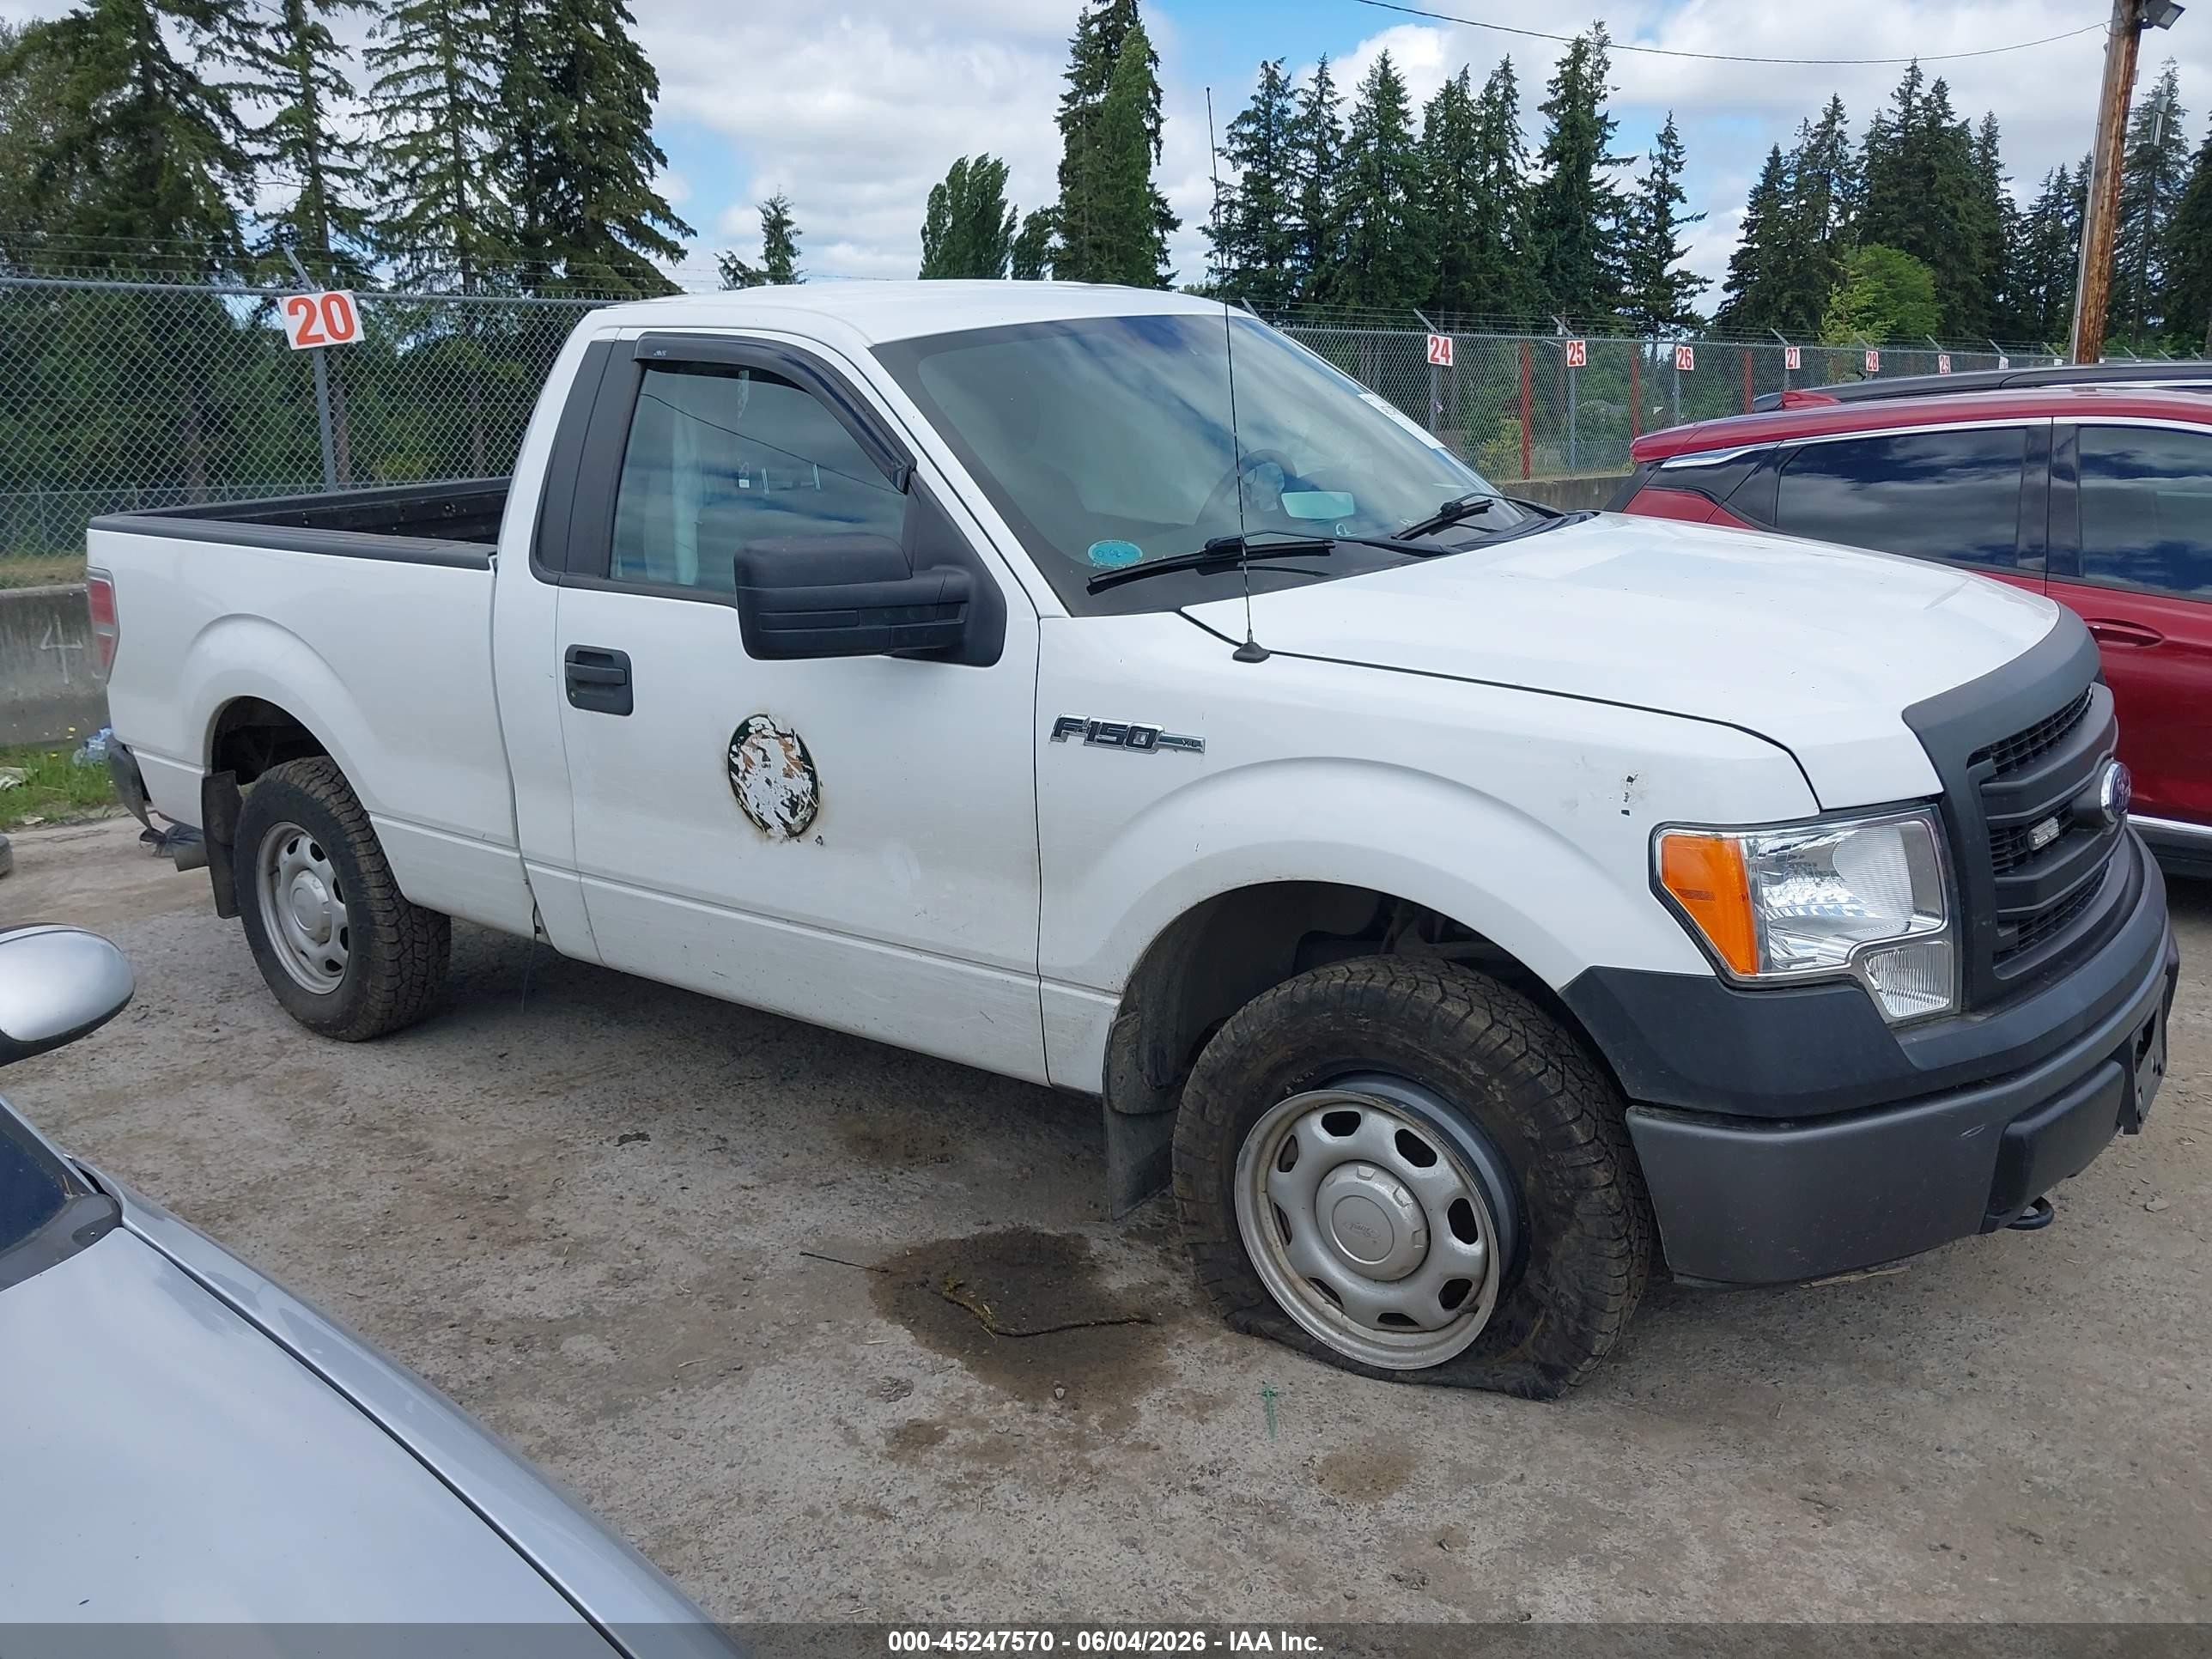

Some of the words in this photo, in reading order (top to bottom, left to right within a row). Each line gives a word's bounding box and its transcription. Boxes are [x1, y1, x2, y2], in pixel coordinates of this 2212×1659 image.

[288, 293, 355, 345] 20
[1430, 337, 1450, 364] 24
[1568, 342, 1584, 365] 25
[1678, 349, 1692, 368] 26
[1787, 349, 1799, 368] 27
[1867, 353, 1879, 370] 28
[1939, 357, 1951, 373] 29
